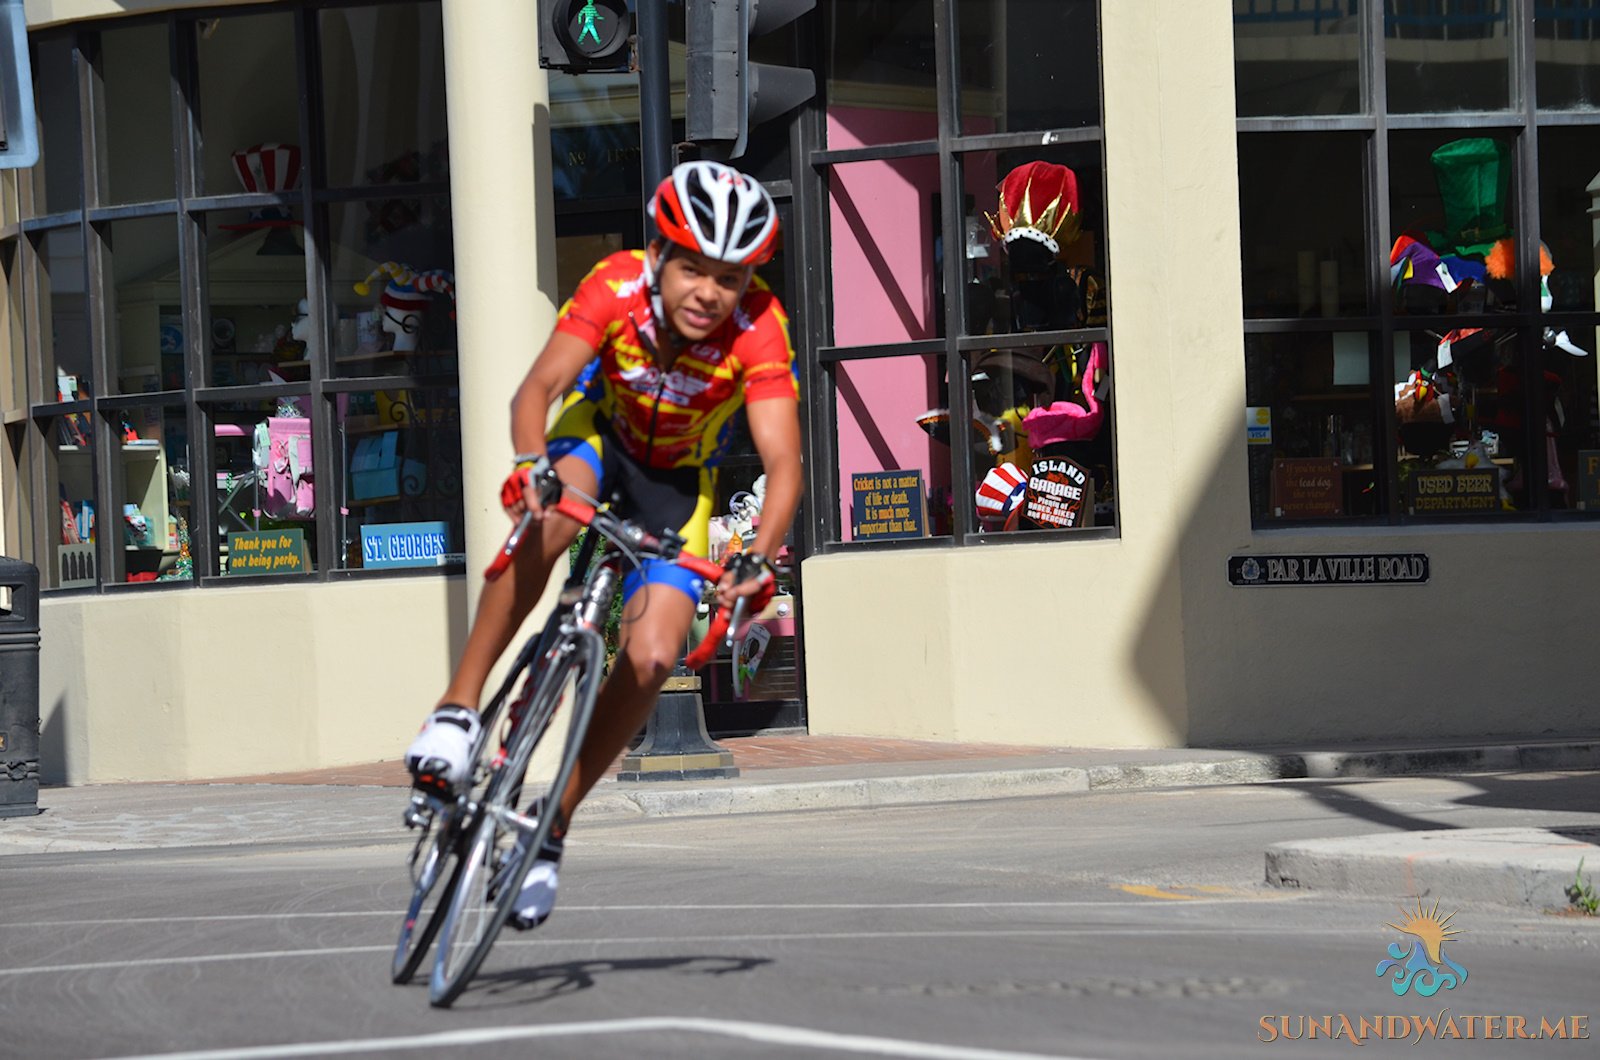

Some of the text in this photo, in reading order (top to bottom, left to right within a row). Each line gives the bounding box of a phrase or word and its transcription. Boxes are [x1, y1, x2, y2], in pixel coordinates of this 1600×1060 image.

[1032, 460, 1086, 485] ISLAND
[854, 477, 918, 491] Cricket is not a matter
[1029, 477, 1082, 500] GARAGE
[1417, 474, 1492, 494] USED BEER
[865, 492, 872, 506] of
[872, 492, 882, 505] life
[883, 495, 890, 505] or
[1060, 502, 1069, 510] of
[1415, 495, 1496, 510] DEPARTMENT
[872, 507, 878, 520] is
[878, 505, 894, 519] much
[895, 508, 910, 518] more
[1053, 508, 1075, 520] BIKES
[859, 521, 888, 537] important
[889, 519, 902, 533] than
[234, 535, 292, 553] Thank you for
[365, 535, 387, 562] ST.
[388, 533, 446, 561] GEORGES
[232, 552, 300, 570] not being perky.
[1266, 558, 1300, 582] PAR
[1378, 555, 1425, 580] ROAD
